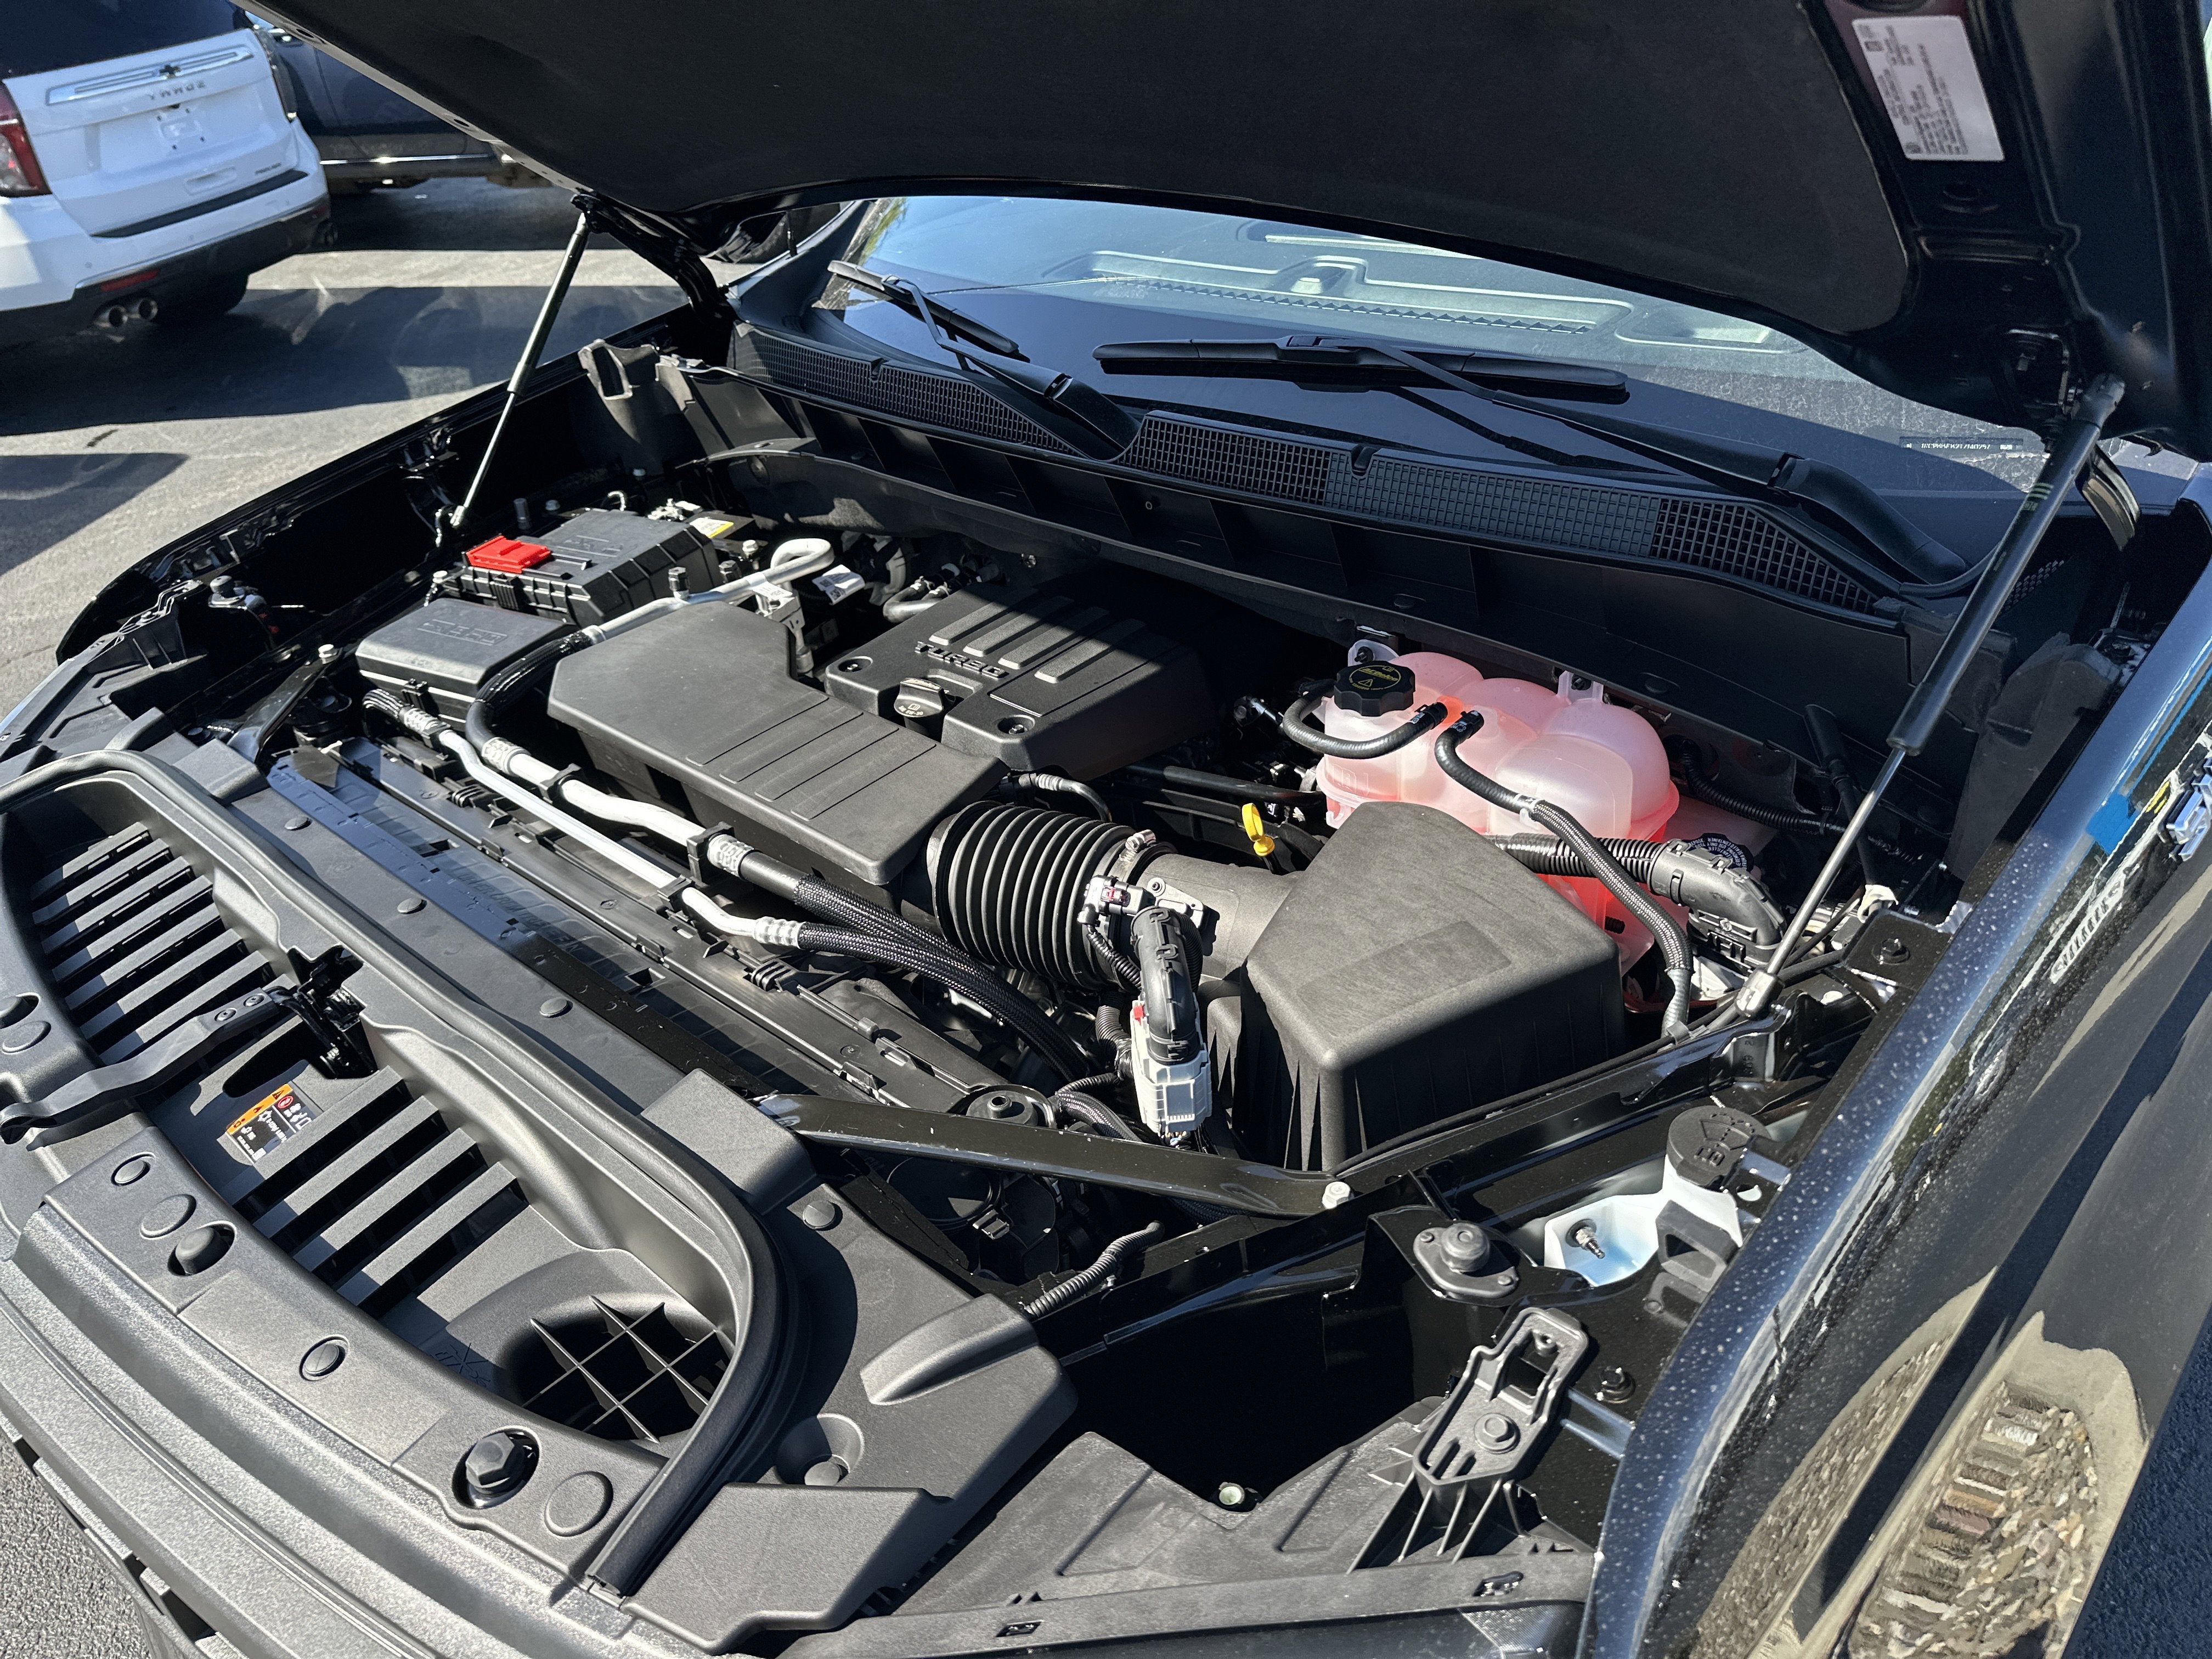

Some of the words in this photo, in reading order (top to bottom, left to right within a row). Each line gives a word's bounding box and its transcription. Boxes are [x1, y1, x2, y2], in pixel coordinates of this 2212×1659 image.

[915, 641, 1008, 680] TURBO
[1359, 668, 1400, 681] ACDelco
[1707, 837, 1731, 847] CONTAINER
